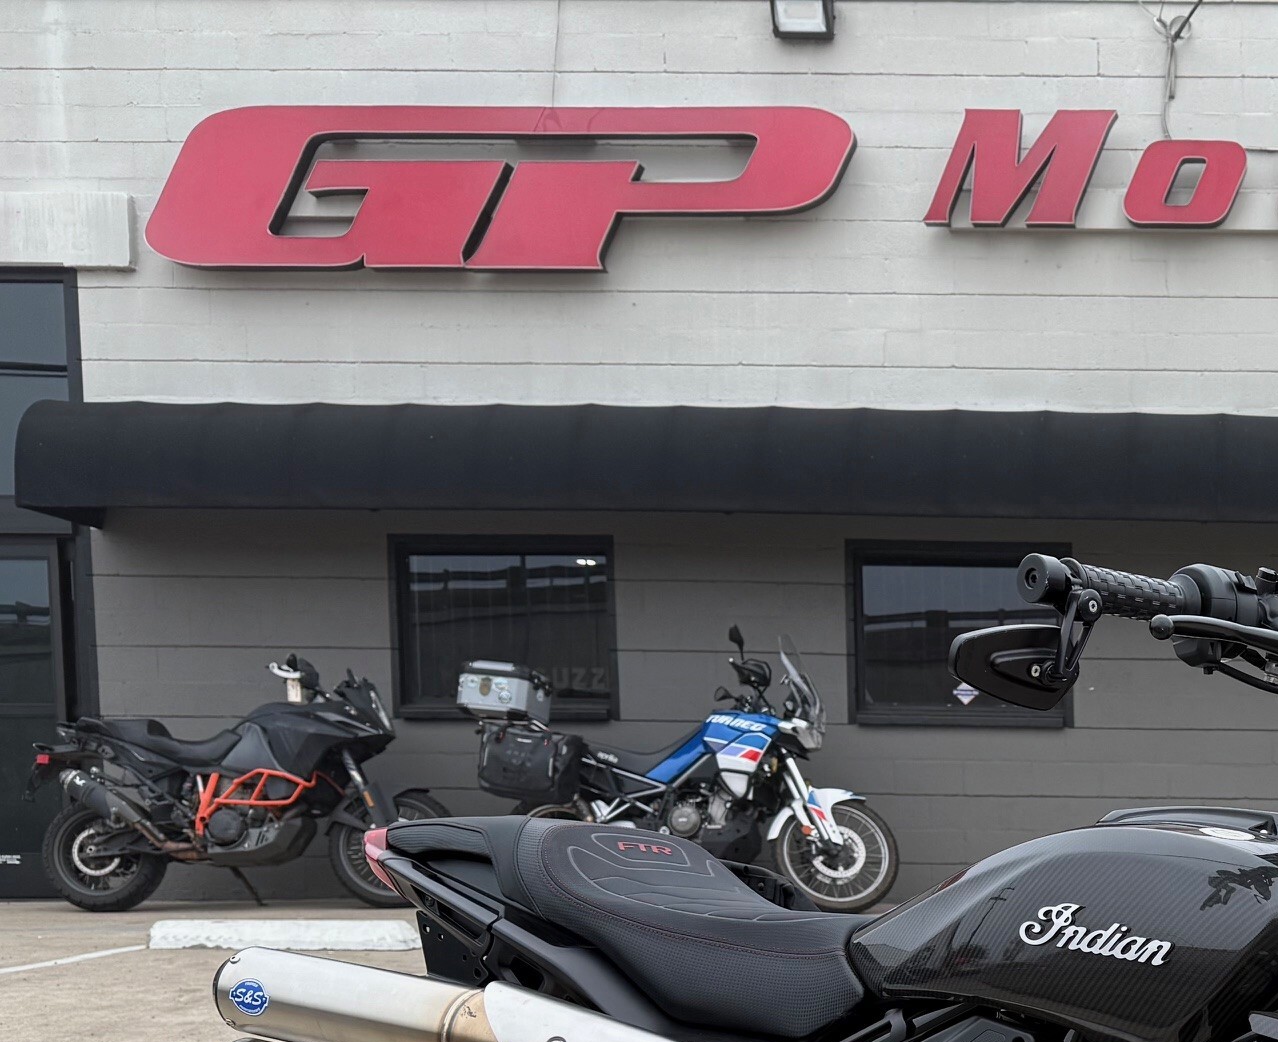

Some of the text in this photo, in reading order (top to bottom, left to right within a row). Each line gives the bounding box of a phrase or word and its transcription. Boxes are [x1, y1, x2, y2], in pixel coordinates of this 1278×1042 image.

[145, 105, 858, 271] GP
[617, 841, 673, 856] FTR
[1019, 902, 1172, 966] Indian
[234, 988, 264, 1005] S&S
